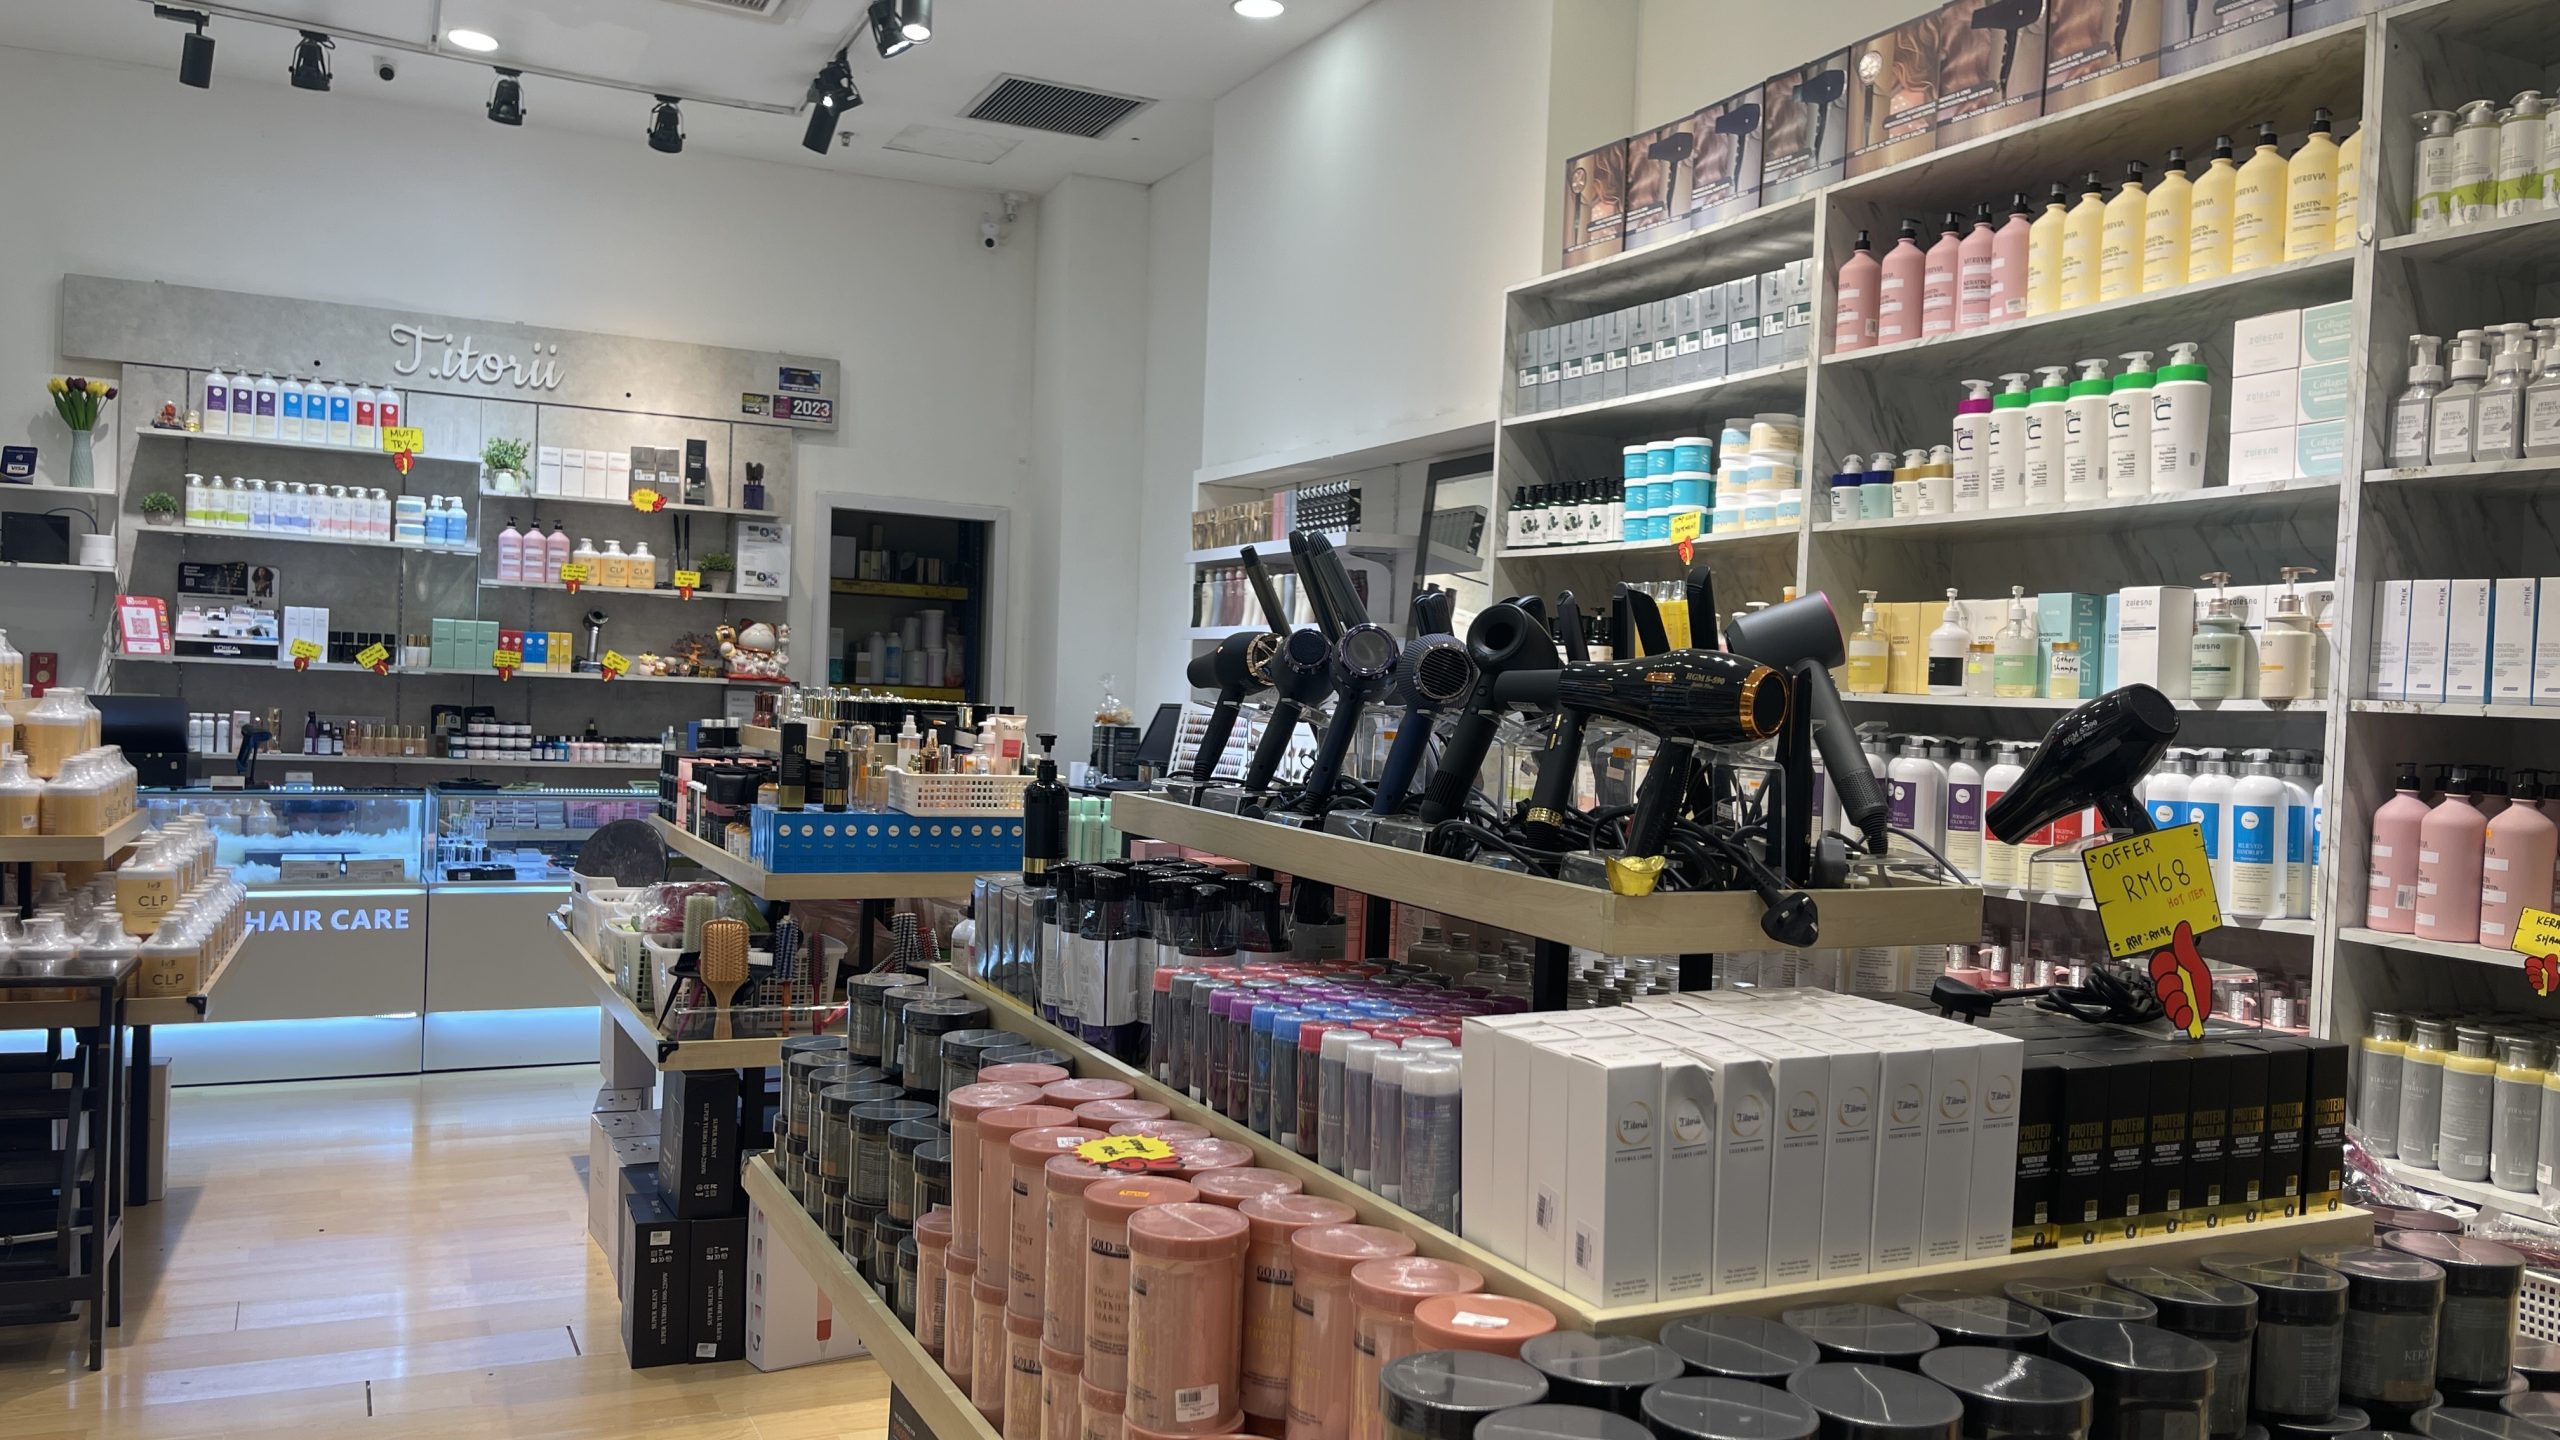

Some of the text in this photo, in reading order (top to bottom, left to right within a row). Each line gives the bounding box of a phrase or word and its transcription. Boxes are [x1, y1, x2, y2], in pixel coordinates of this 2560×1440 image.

[793, 399, 830, 417] 2023
[391, 429, 414, 438] MUST
[2102, 838, 2154, 869] OFFER
[2122, 859, 2191, 902] RM68
[138, 894, 168, 908] CLP
[2168, 893, 2184, 909] HOT
[245, 908, 410, 933] HAIR CARE
[152, 973, 185, 987] CLP
[1092, 1237, 1113, 1251] GOLD
[1257, 1265, 1287, 1278] GOLD
